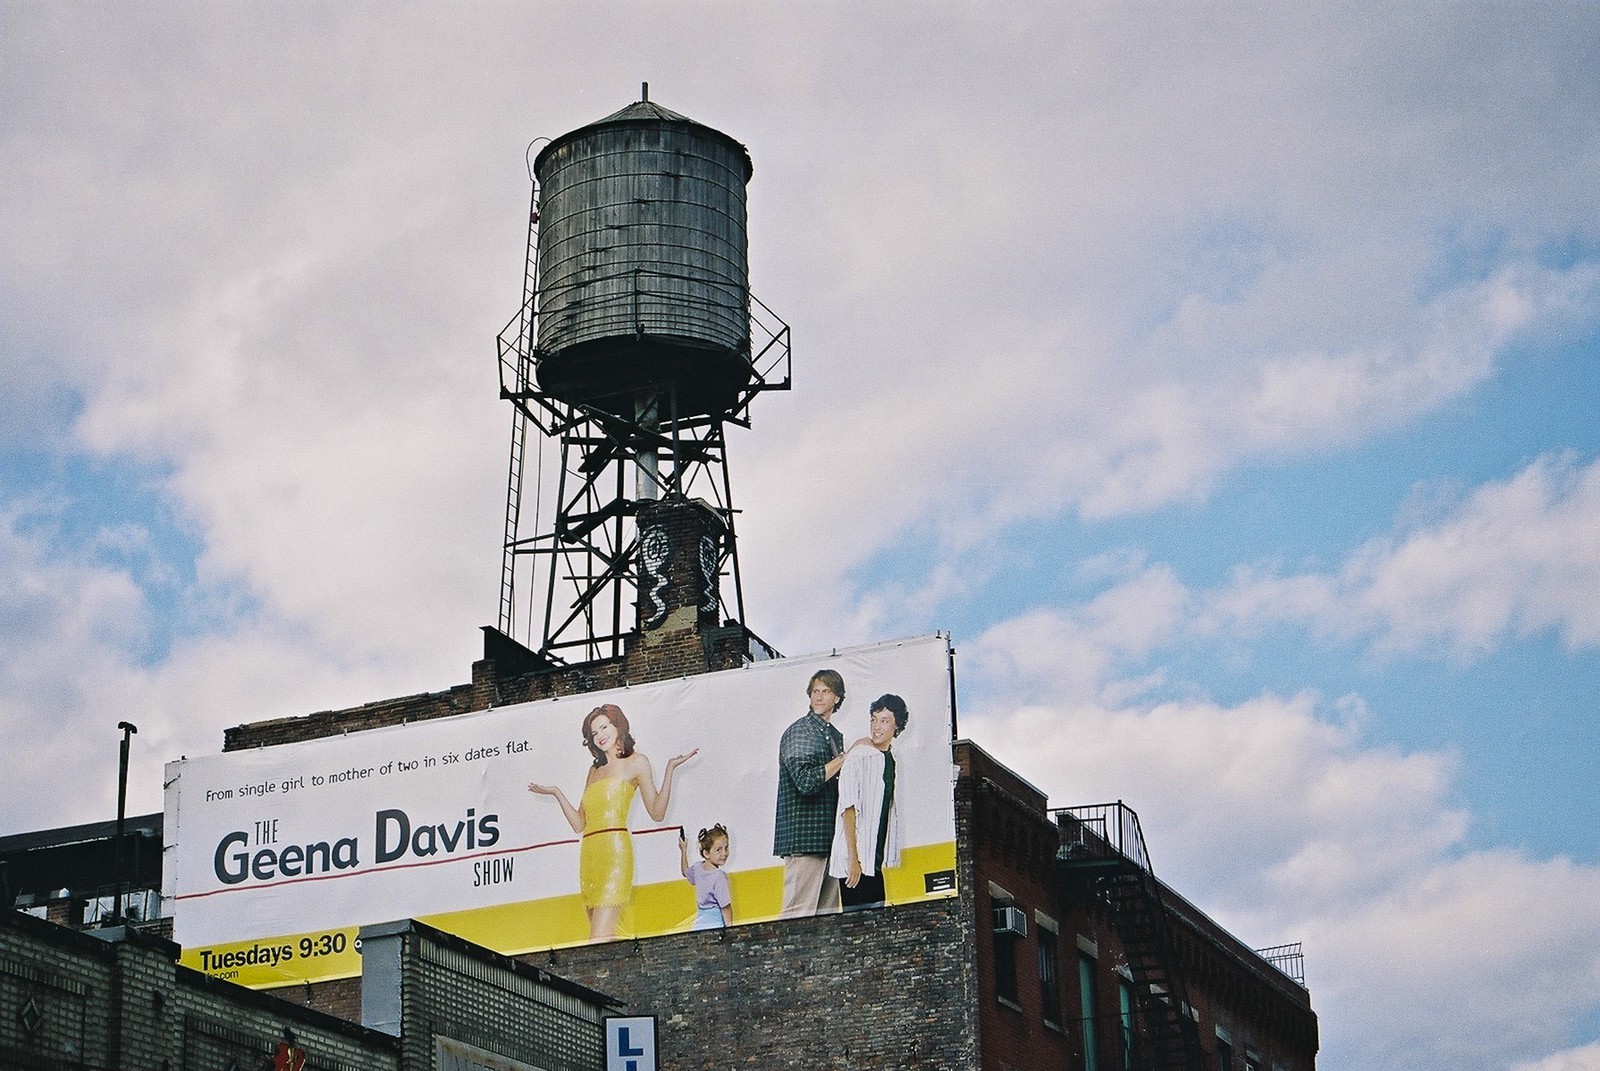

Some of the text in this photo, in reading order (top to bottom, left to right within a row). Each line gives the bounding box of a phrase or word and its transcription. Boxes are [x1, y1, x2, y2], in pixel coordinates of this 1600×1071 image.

[206, 740, 533, 801] From single girl to mother of two in six dates flat.
[214, 808, 500, 885] Geena Davis
[254, 819, 278, 845] THE
[473, 857, 514, 887] SHOW
[200, 944, 293, 971] Tuesdays
[299, 933, 347, 959] 9:30
